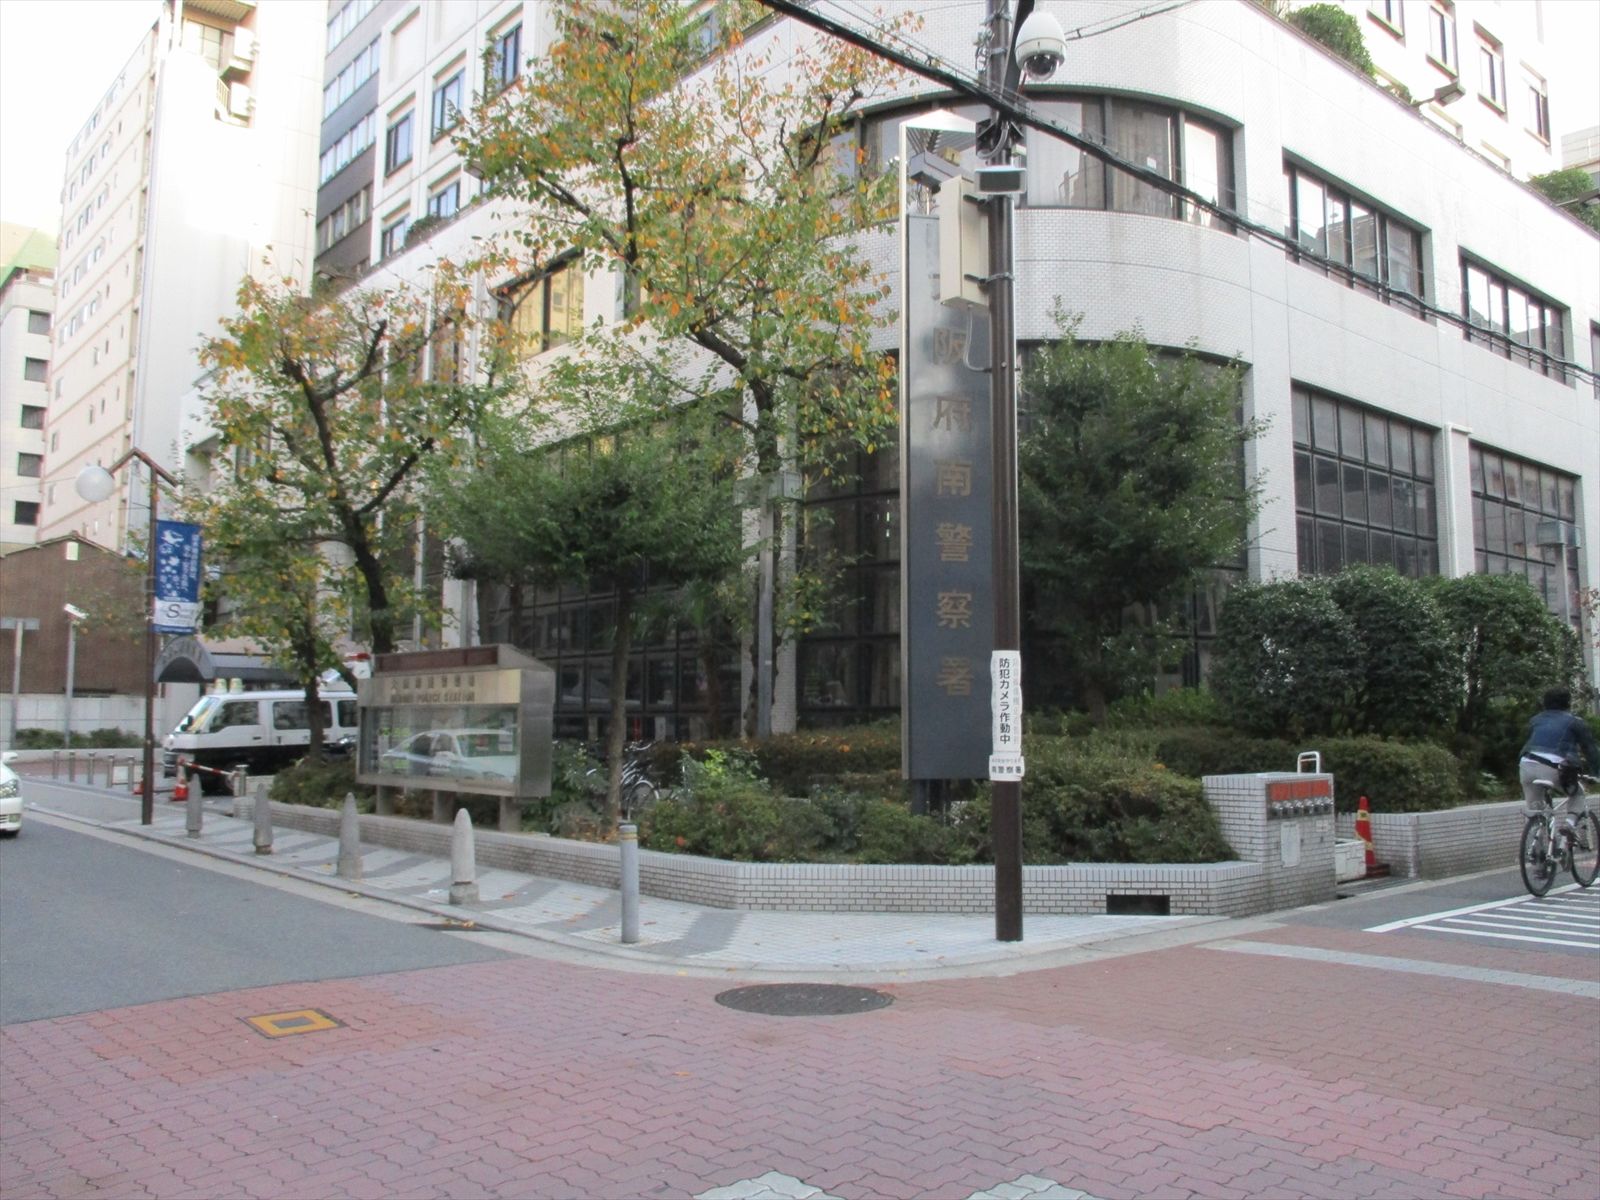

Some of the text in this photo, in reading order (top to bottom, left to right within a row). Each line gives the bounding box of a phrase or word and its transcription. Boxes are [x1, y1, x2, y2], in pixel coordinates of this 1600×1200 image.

[930, 272, 974, 696] 阪府南警察署
[999, 657, 1011, 745] 防犯カメラ作動中
